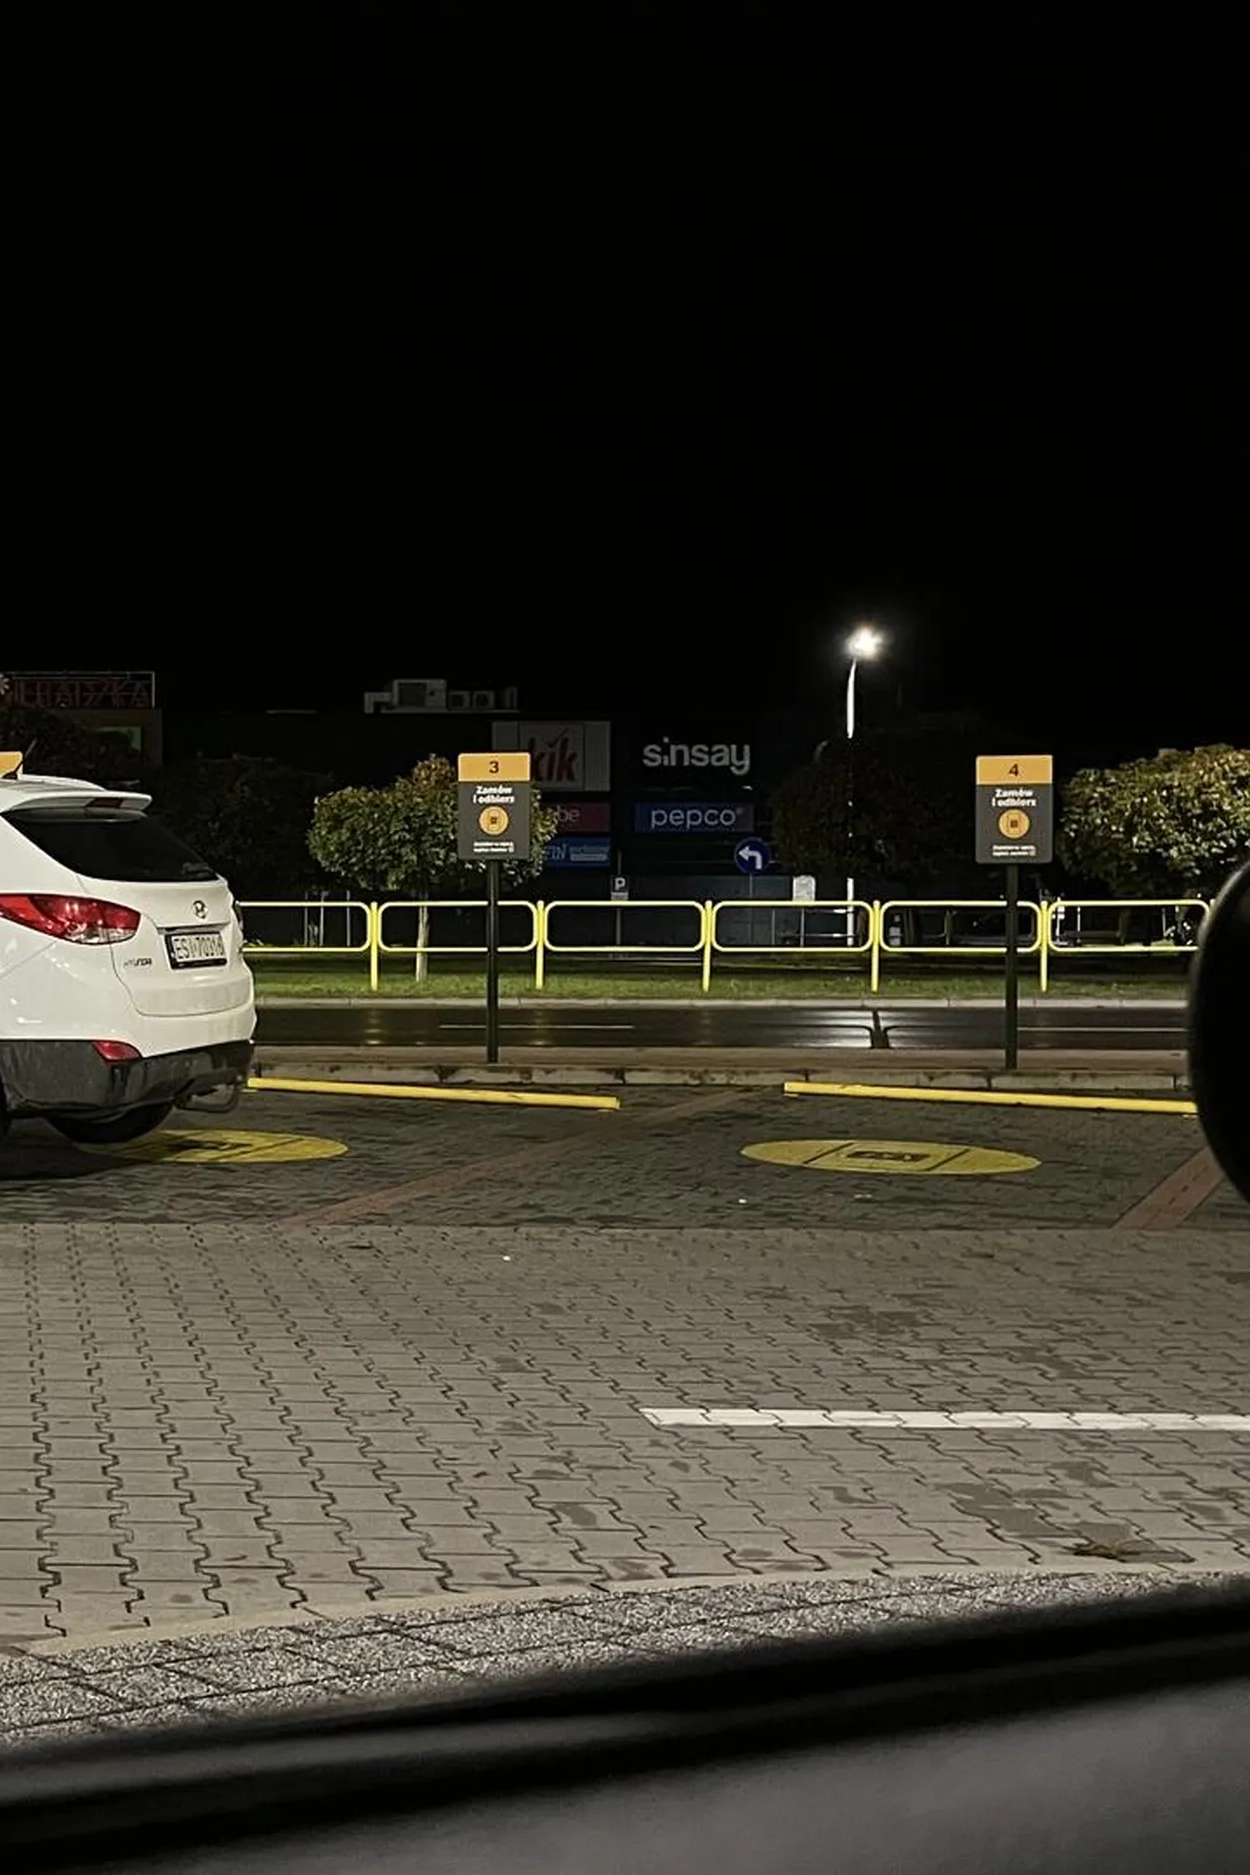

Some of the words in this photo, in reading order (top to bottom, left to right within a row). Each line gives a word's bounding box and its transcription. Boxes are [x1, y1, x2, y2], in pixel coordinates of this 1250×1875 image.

[642, 736, 751, 776] sinsay
[488, 760, 500, 774] 3
[1008, 763, 1019, 777] 4
[650, 808, 736, 831] pepco
[614, 877, 626, 891] P
